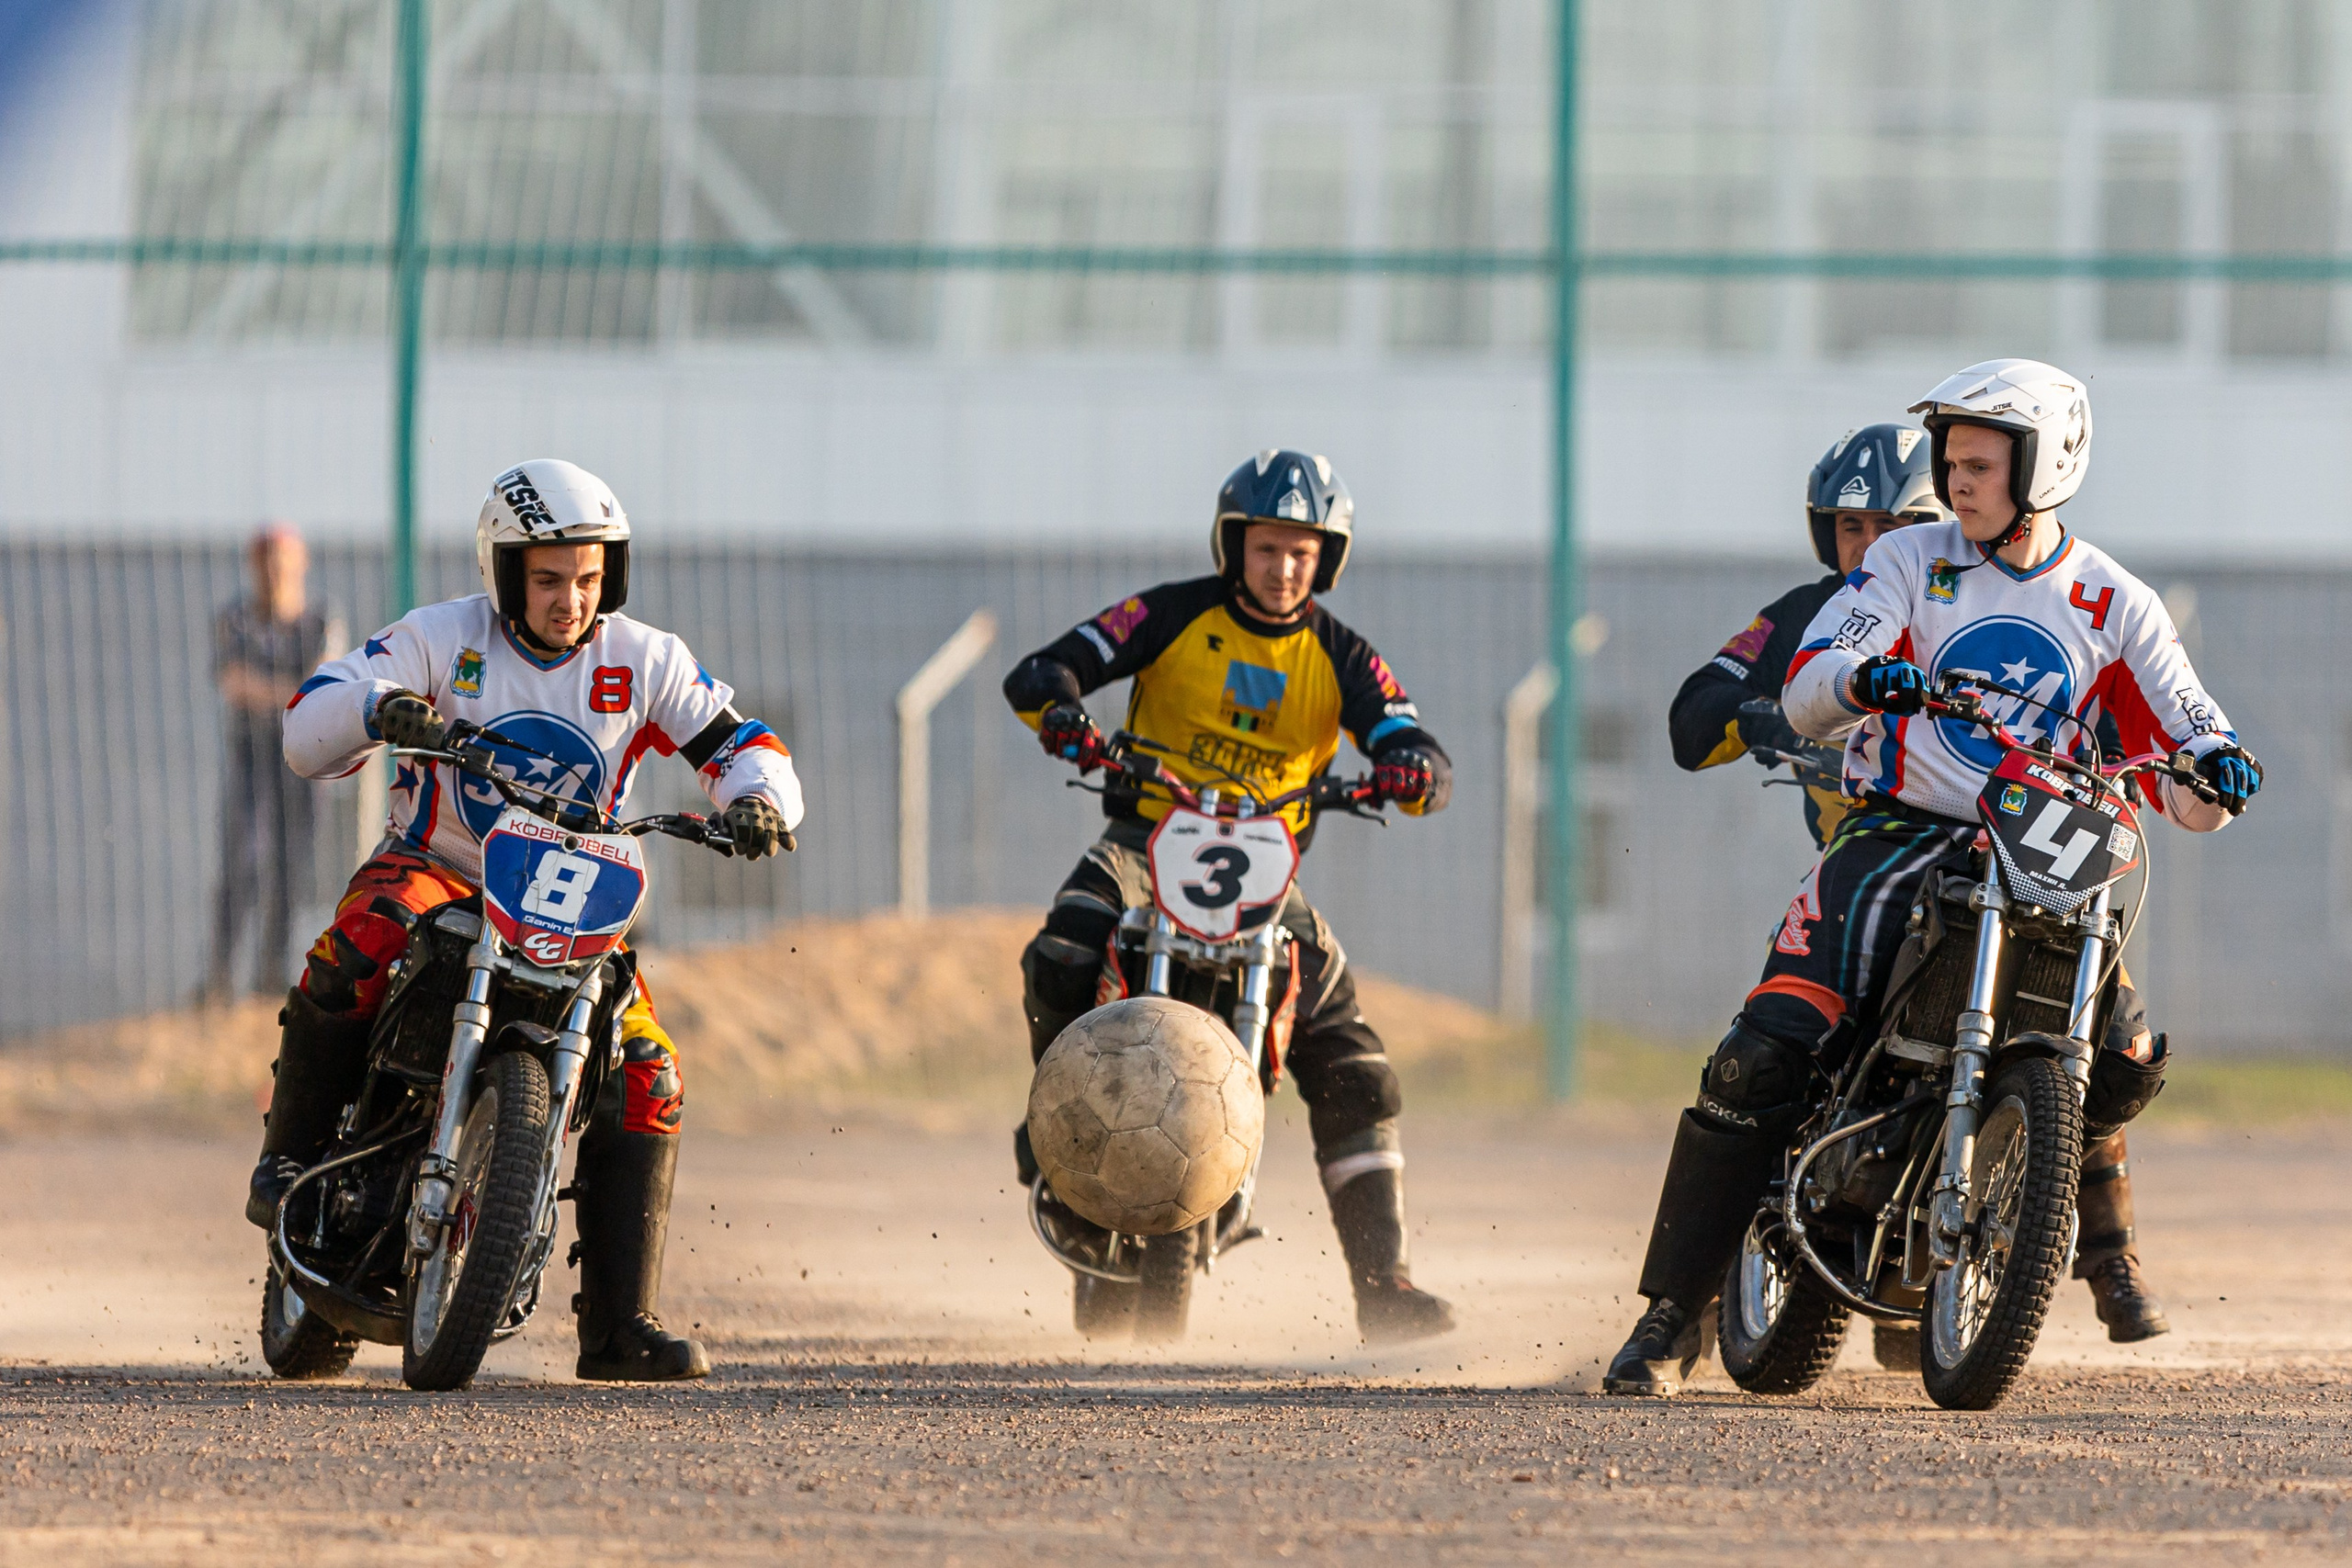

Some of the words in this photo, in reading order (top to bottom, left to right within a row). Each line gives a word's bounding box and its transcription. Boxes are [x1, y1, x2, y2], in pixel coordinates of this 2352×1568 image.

[2069, 581, 2115, 631] 4
[589, 665, 633, 713] 8
[2019, 798, 2100, 881] 4
[521, 850, 600, 923] 8
[1182, 843, 1250, 908] 3
[2029, 870, 2058, 886] МАХИН
[523, 914, 562, 931] Ganin
